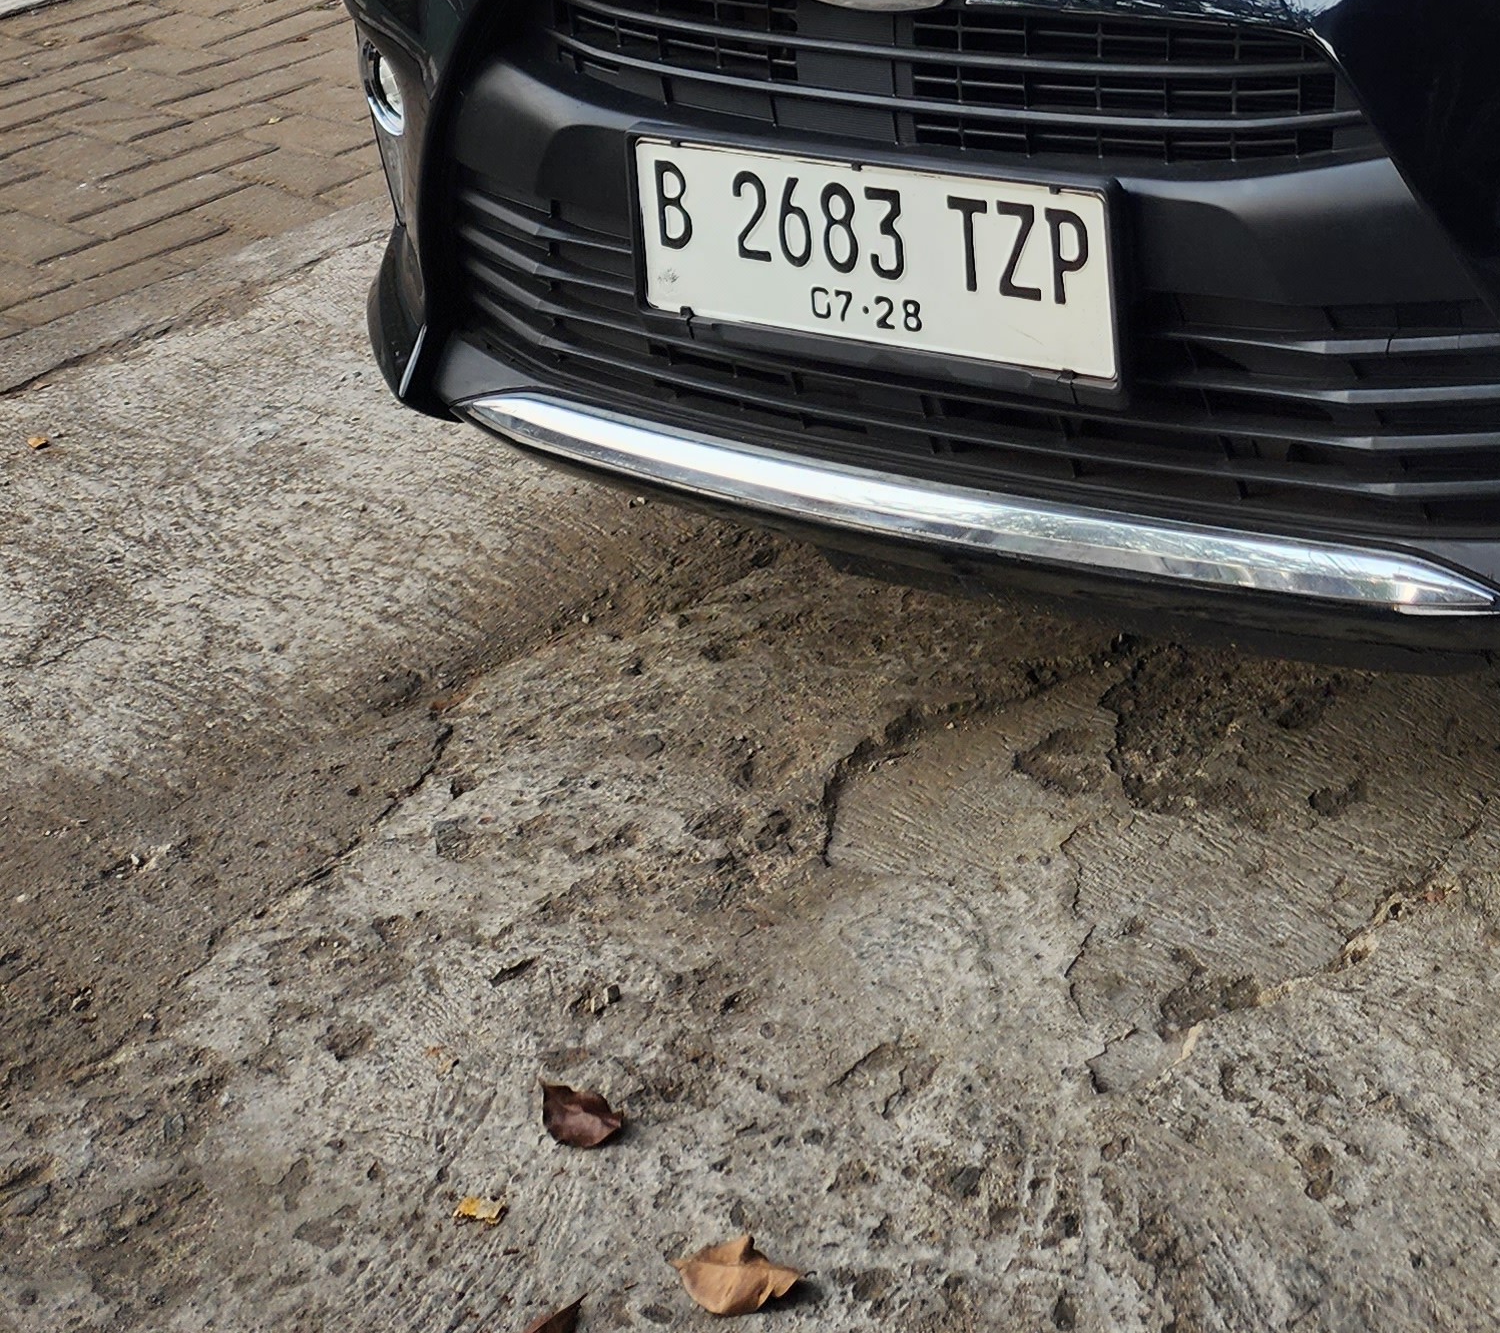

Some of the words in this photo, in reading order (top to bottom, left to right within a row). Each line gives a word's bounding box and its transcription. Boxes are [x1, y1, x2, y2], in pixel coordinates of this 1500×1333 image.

[653, 159, 693, 250] B
[731, 170, 905, 281] 2683
[946, 194, 1090, 305] TZP
